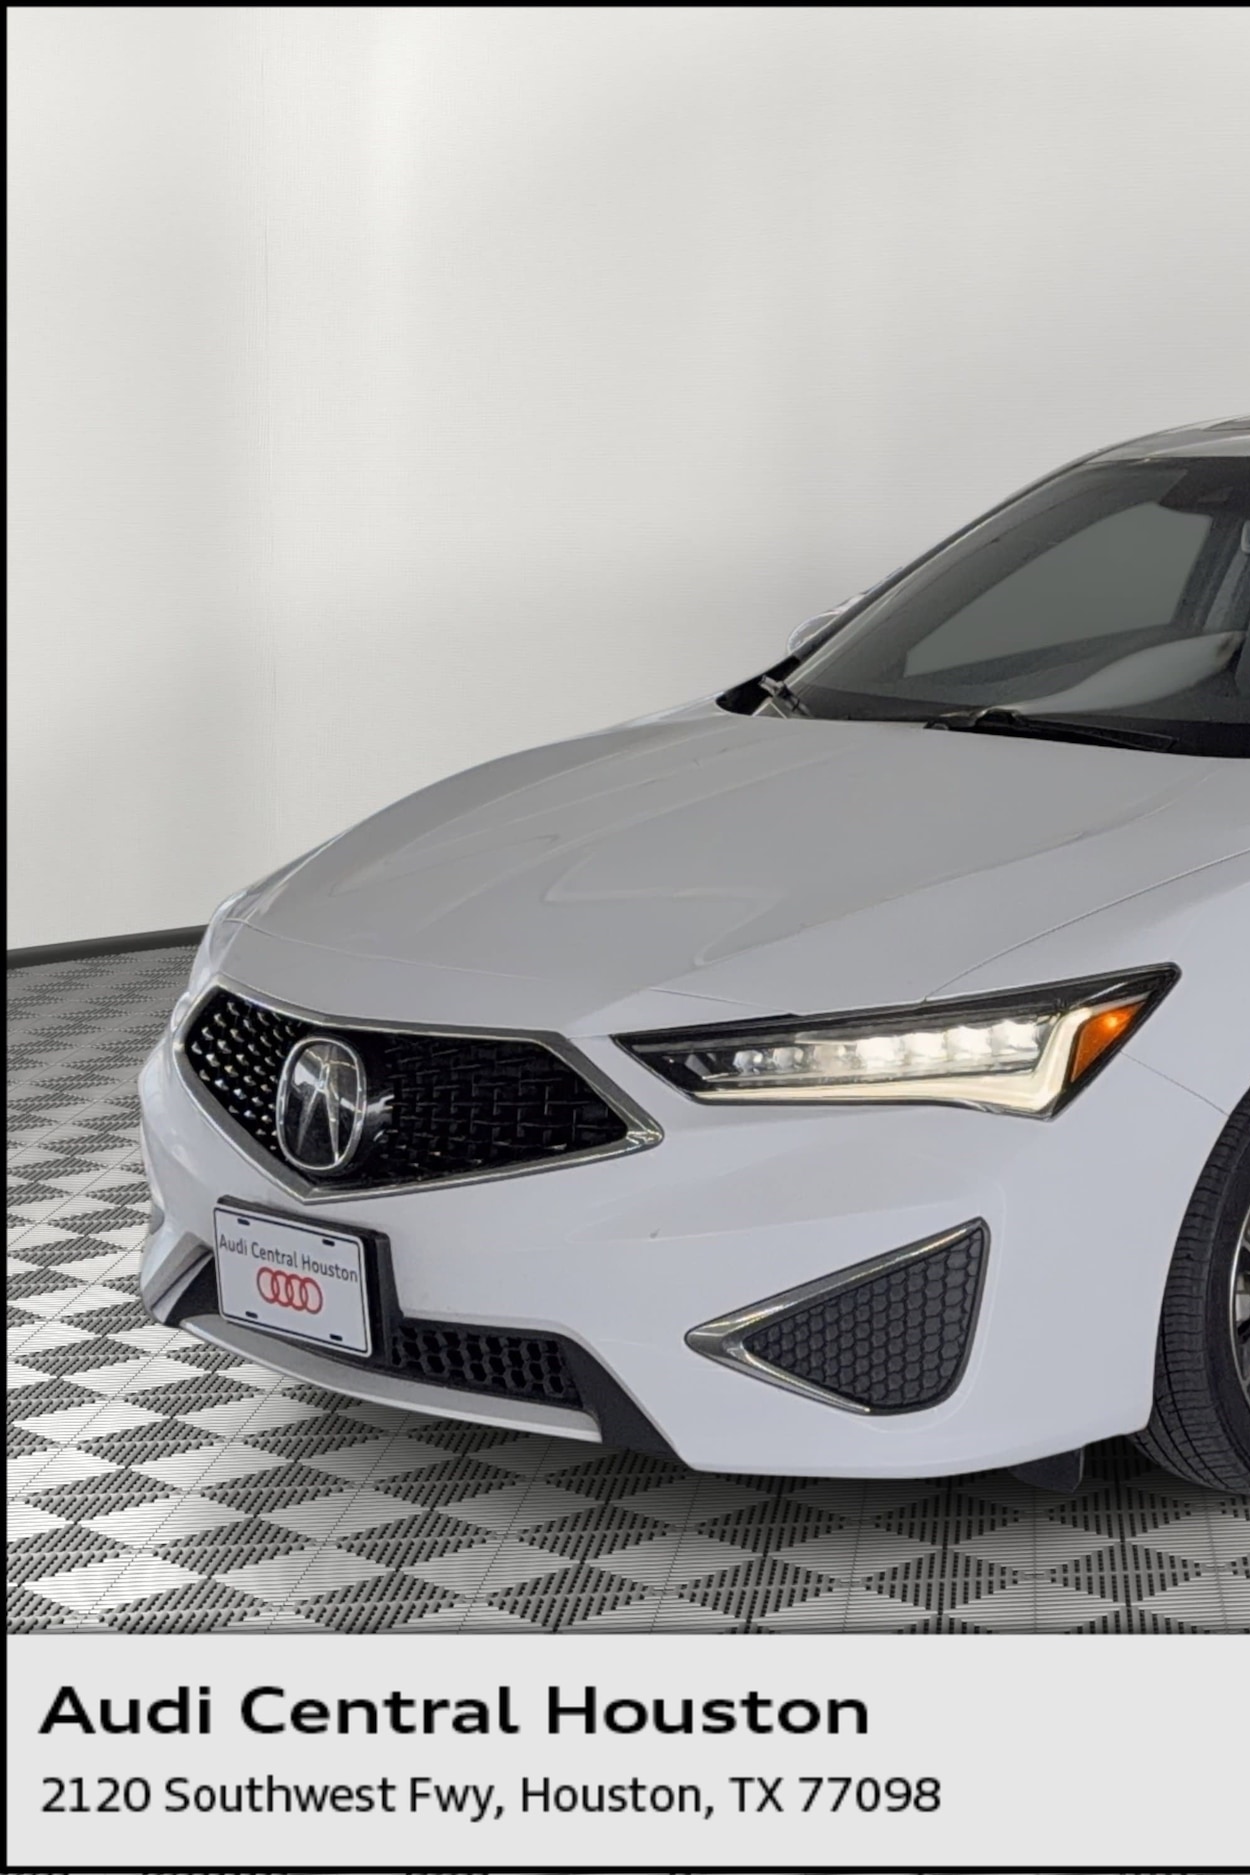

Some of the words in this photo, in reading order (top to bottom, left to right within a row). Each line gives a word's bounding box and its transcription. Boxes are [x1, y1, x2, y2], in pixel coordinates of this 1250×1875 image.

[219, 1233, 248, 1256] Audi
[251, 1241, 298, 1268] Central
[301, 1253, 358, 1283] Houston
